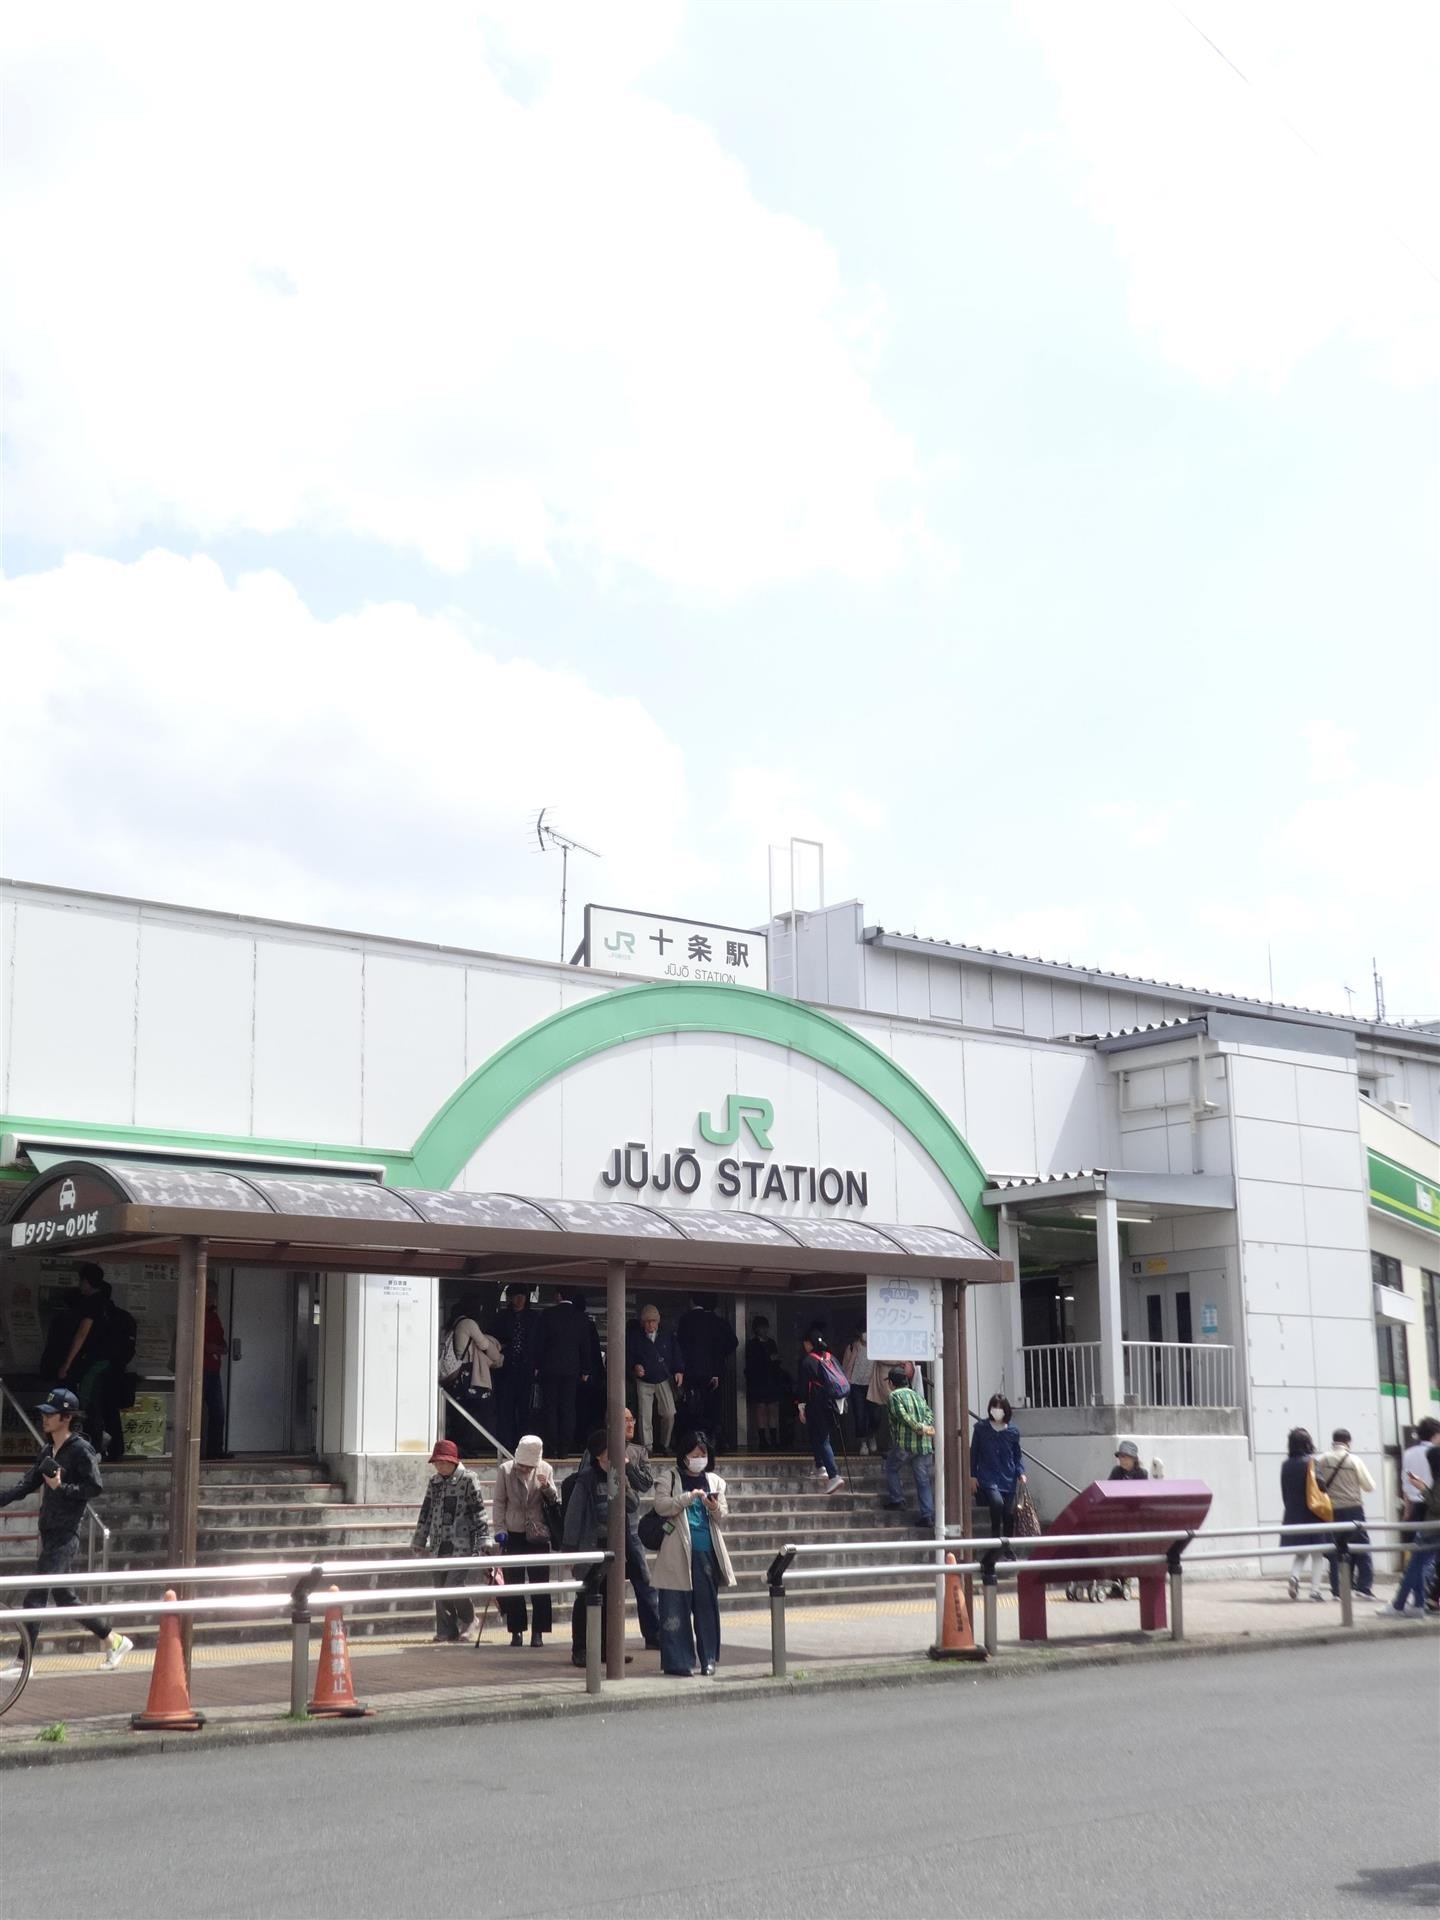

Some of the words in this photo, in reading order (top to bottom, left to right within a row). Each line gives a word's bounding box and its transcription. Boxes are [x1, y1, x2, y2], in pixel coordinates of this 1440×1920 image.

[604, 931, 636, 954] JR
[649, 928, 750, 968] 十条駅
[694, 969, 736, 985] STATION
[699, 1094, 774, 1150] JR
[602, 1142, 701, 1195] JŪJŌ
[718, 1158, 868, 1206] STATION
[26, 1210, 98, 1244] タクシーのりば
[892, 1288, 908, 1299] TAXI
[875, 1307, 925, 1325] タクシー
[872, 1332, 927, 1354] のりば
